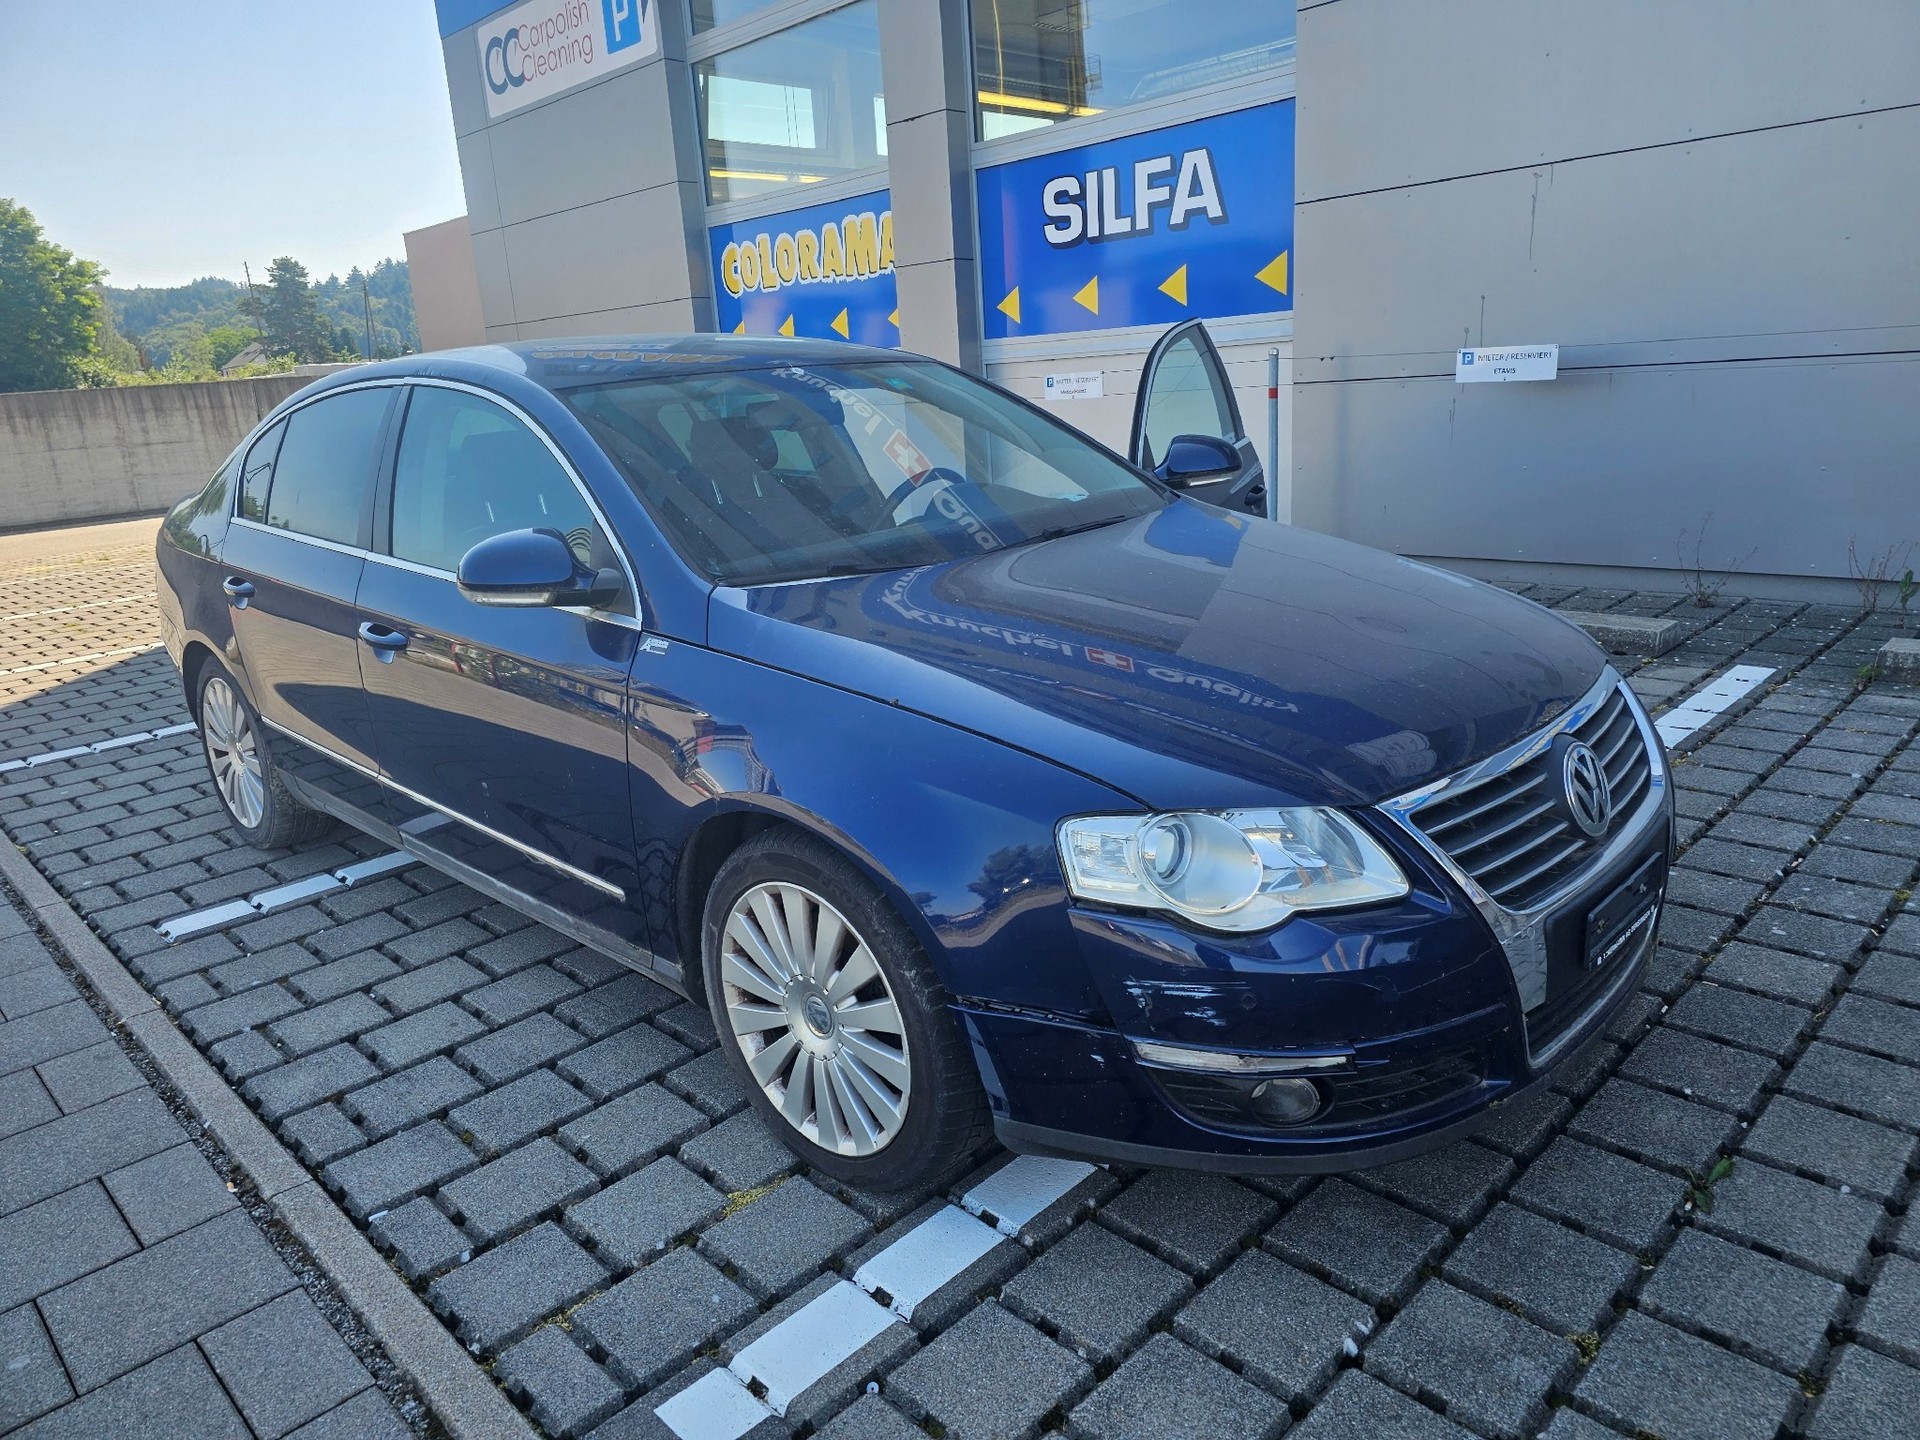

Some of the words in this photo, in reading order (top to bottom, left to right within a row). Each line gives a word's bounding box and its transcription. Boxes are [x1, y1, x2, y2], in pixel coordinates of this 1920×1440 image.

[517, 0, 590, 51] Carpolish
[522, 33, 594, 82] Cleaning
[1043, 147, 1226, 246] SILFA
[722, 212, 895, 297] COLORAMA
[1478, 353, 1504, 362] MIETER
[1510, 351, 1552, 360] RESERVIERT
[1493, 367, 1516, 375] ETAVIS
